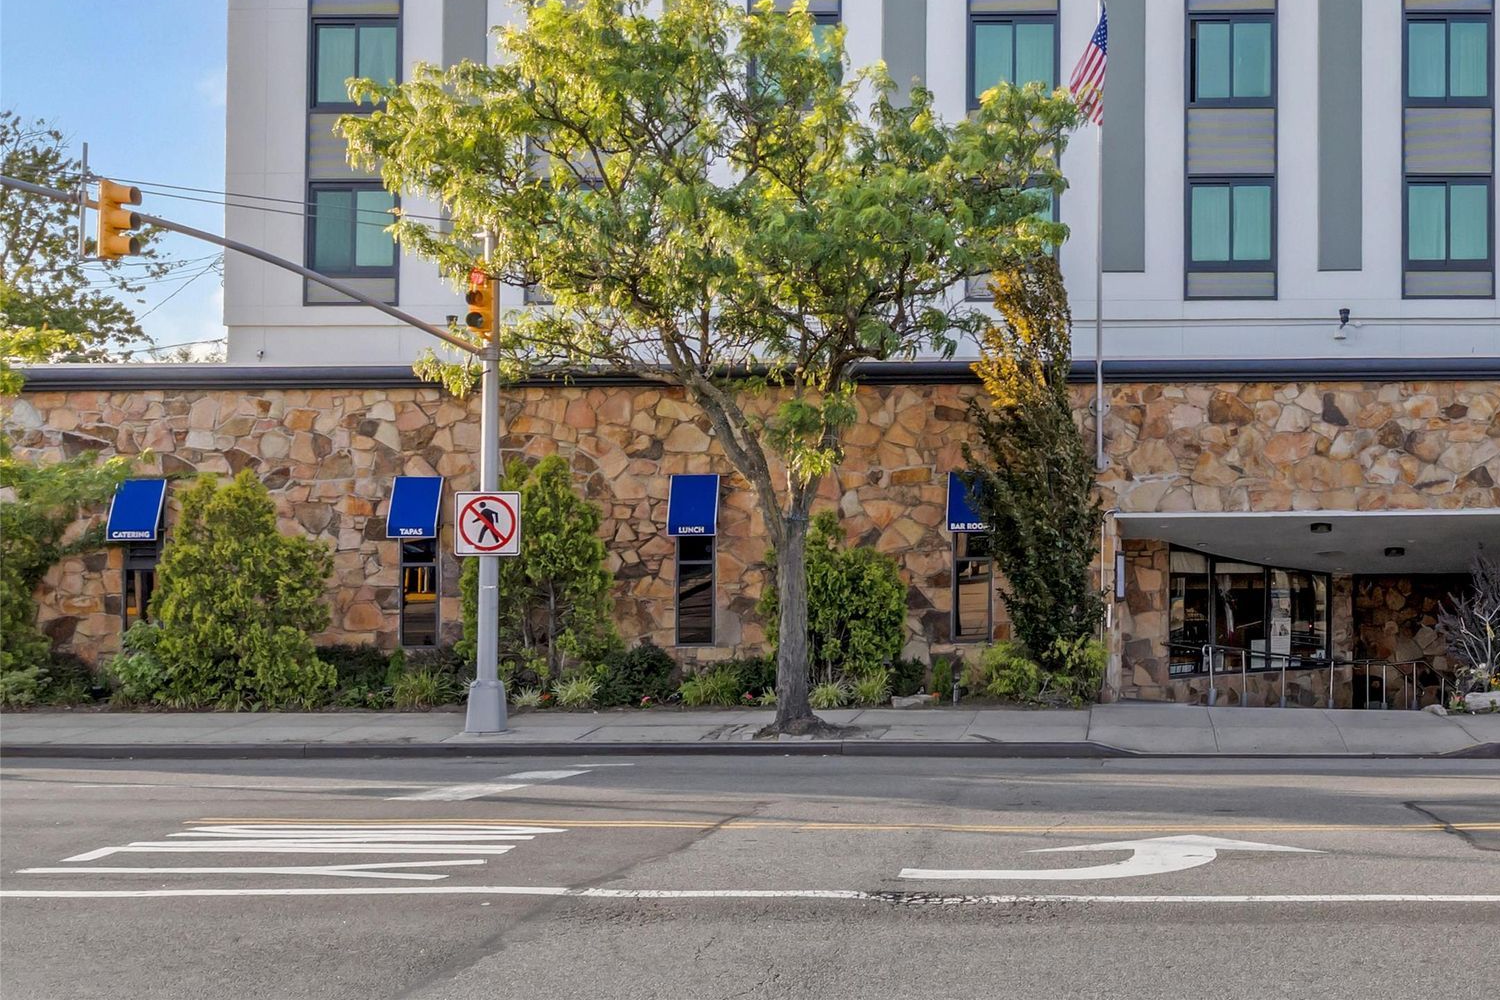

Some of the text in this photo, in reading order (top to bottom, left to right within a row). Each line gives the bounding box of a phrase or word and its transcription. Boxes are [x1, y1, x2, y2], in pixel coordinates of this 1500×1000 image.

[399, 528, 423, 536] TAPAS
[678, 526, 705, 534] LUNCH
[14, 824, 568, 881] ONLY
